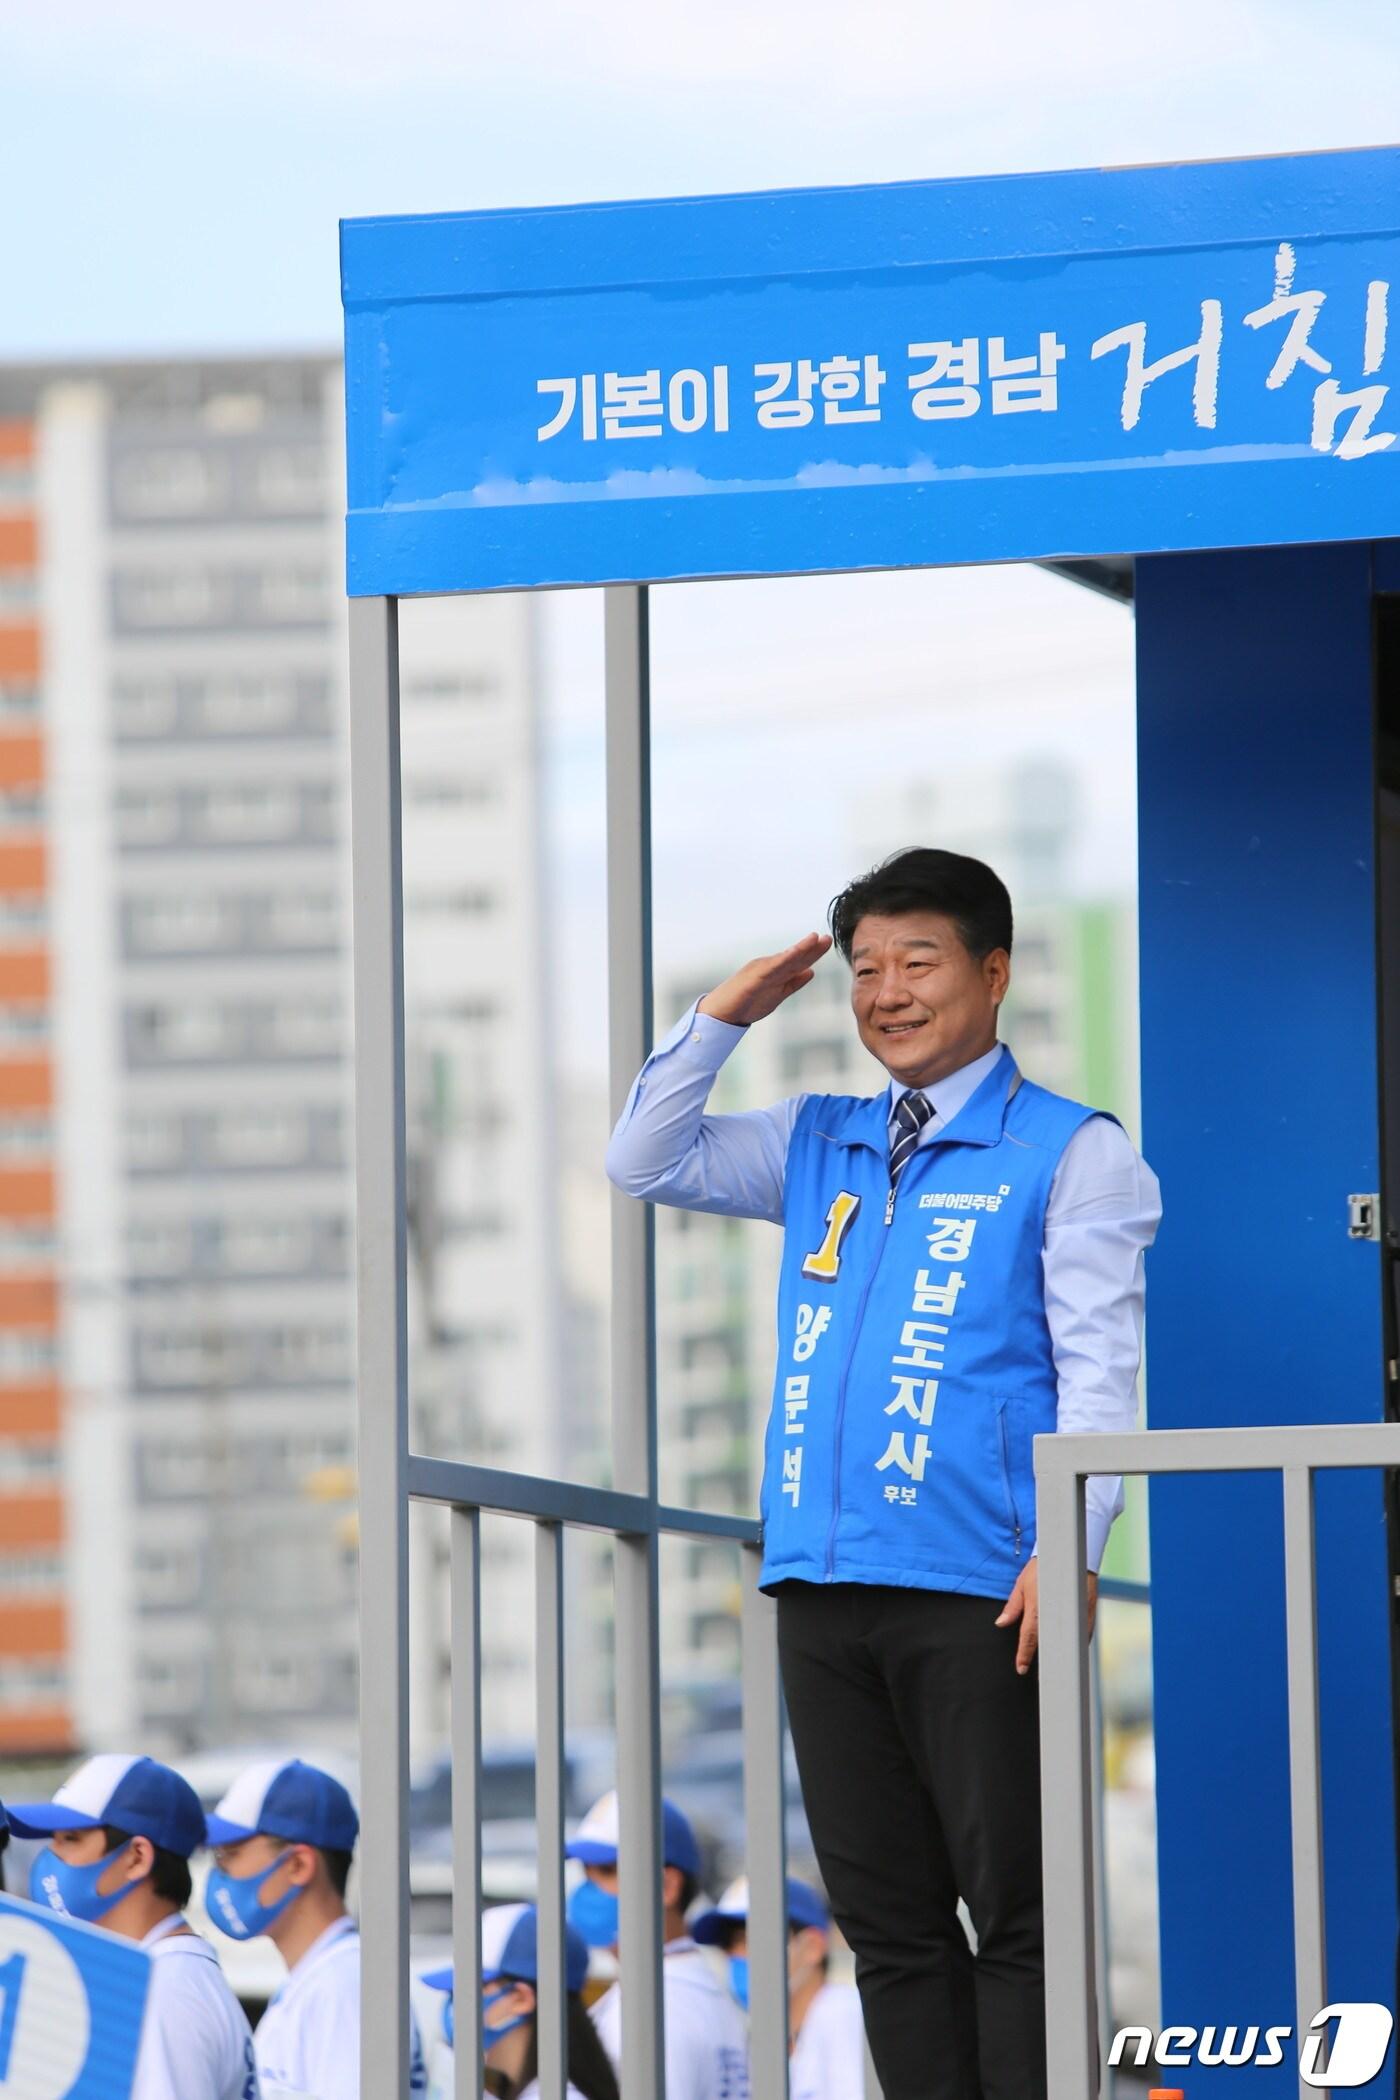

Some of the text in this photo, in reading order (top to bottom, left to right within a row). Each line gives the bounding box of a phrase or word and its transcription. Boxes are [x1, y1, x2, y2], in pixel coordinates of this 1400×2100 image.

[537, 242, 1397, 460] 기본이 강한 경남 거침
[801, 1190, 861, 1284] 1
[918, 1192, 1003, 1212] 더불어민주당
[782, 1303, 833, 1507] 양문석
[874, 1216, 977, 1481] 경남도지사
[883, 1485, 917, 1506] 후보
